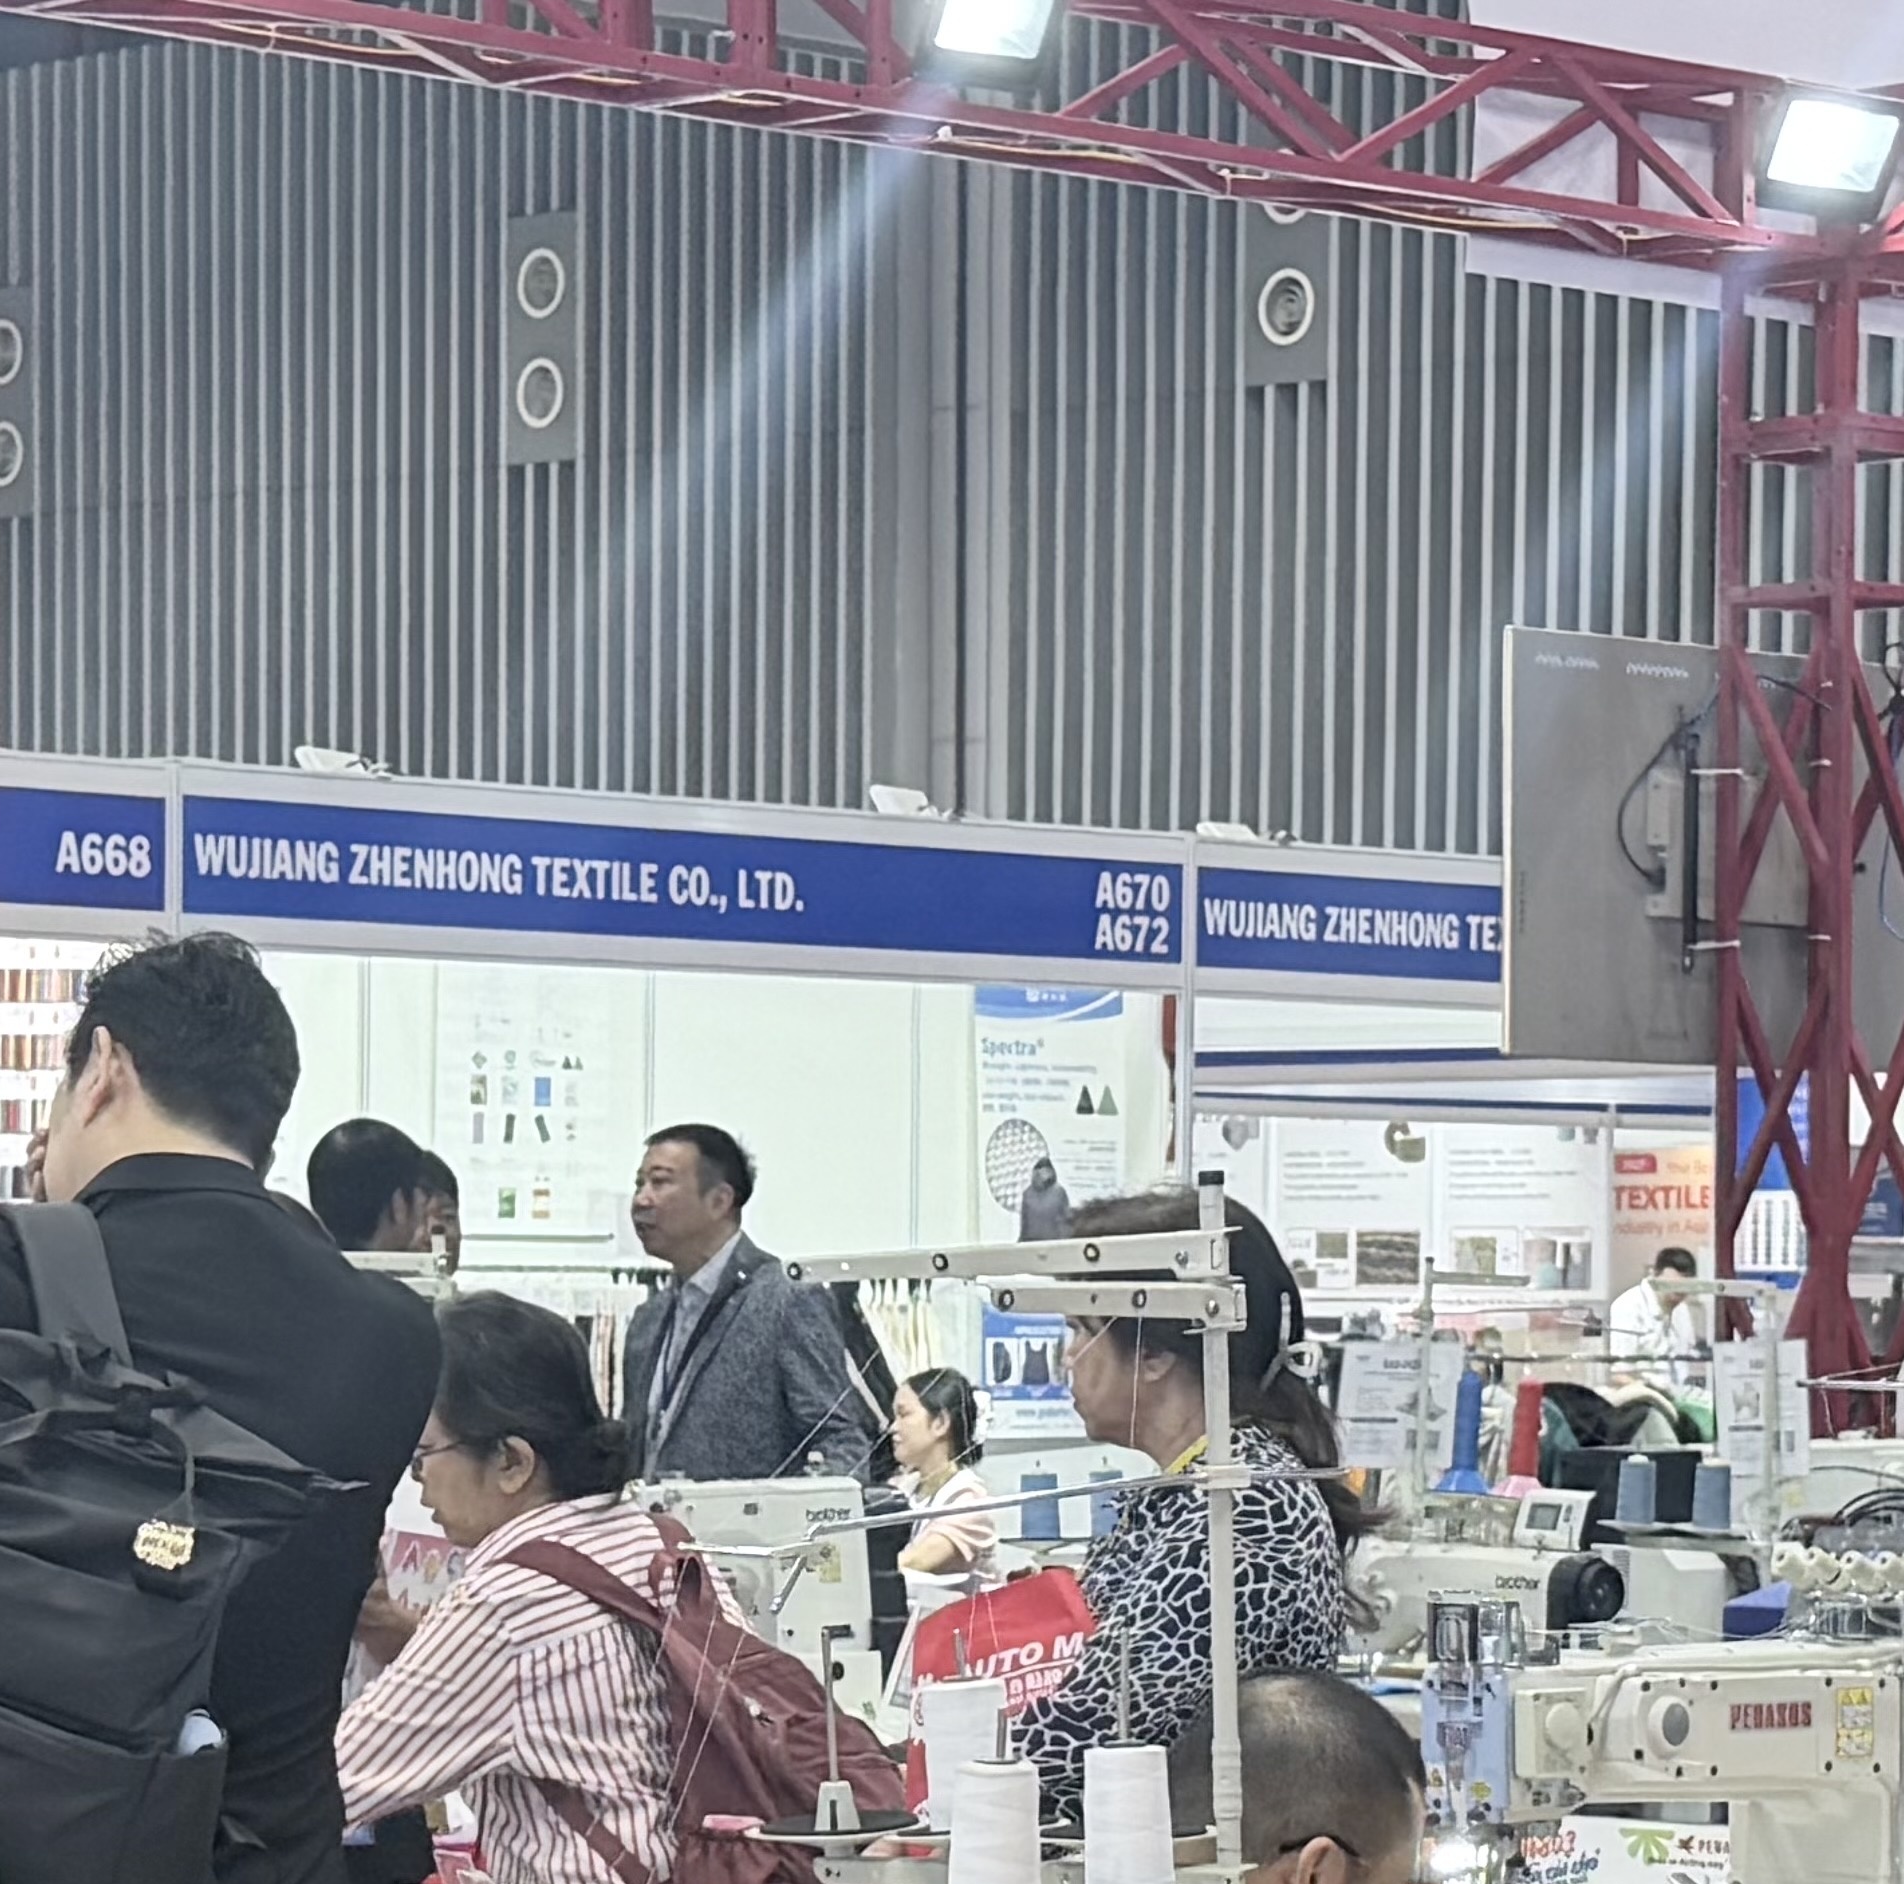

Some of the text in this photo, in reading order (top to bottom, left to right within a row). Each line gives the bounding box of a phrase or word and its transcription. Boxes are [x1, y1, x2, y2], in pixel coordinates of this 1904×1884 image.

[55, 830, 152, 878] A668
[194, 834, 806, 915] WUJIANG ZHENHONG TEXTILE CO., LTD.
[1096, 871, 1171, 911] A670
[1095, 914, 1170, 954] A672
[1203, 897, 1318, 942] WUJIANG
[1322, 905, 1460, 952] ZHENHONG
[1613, 1184, 1711, 1210] TEXTILE
